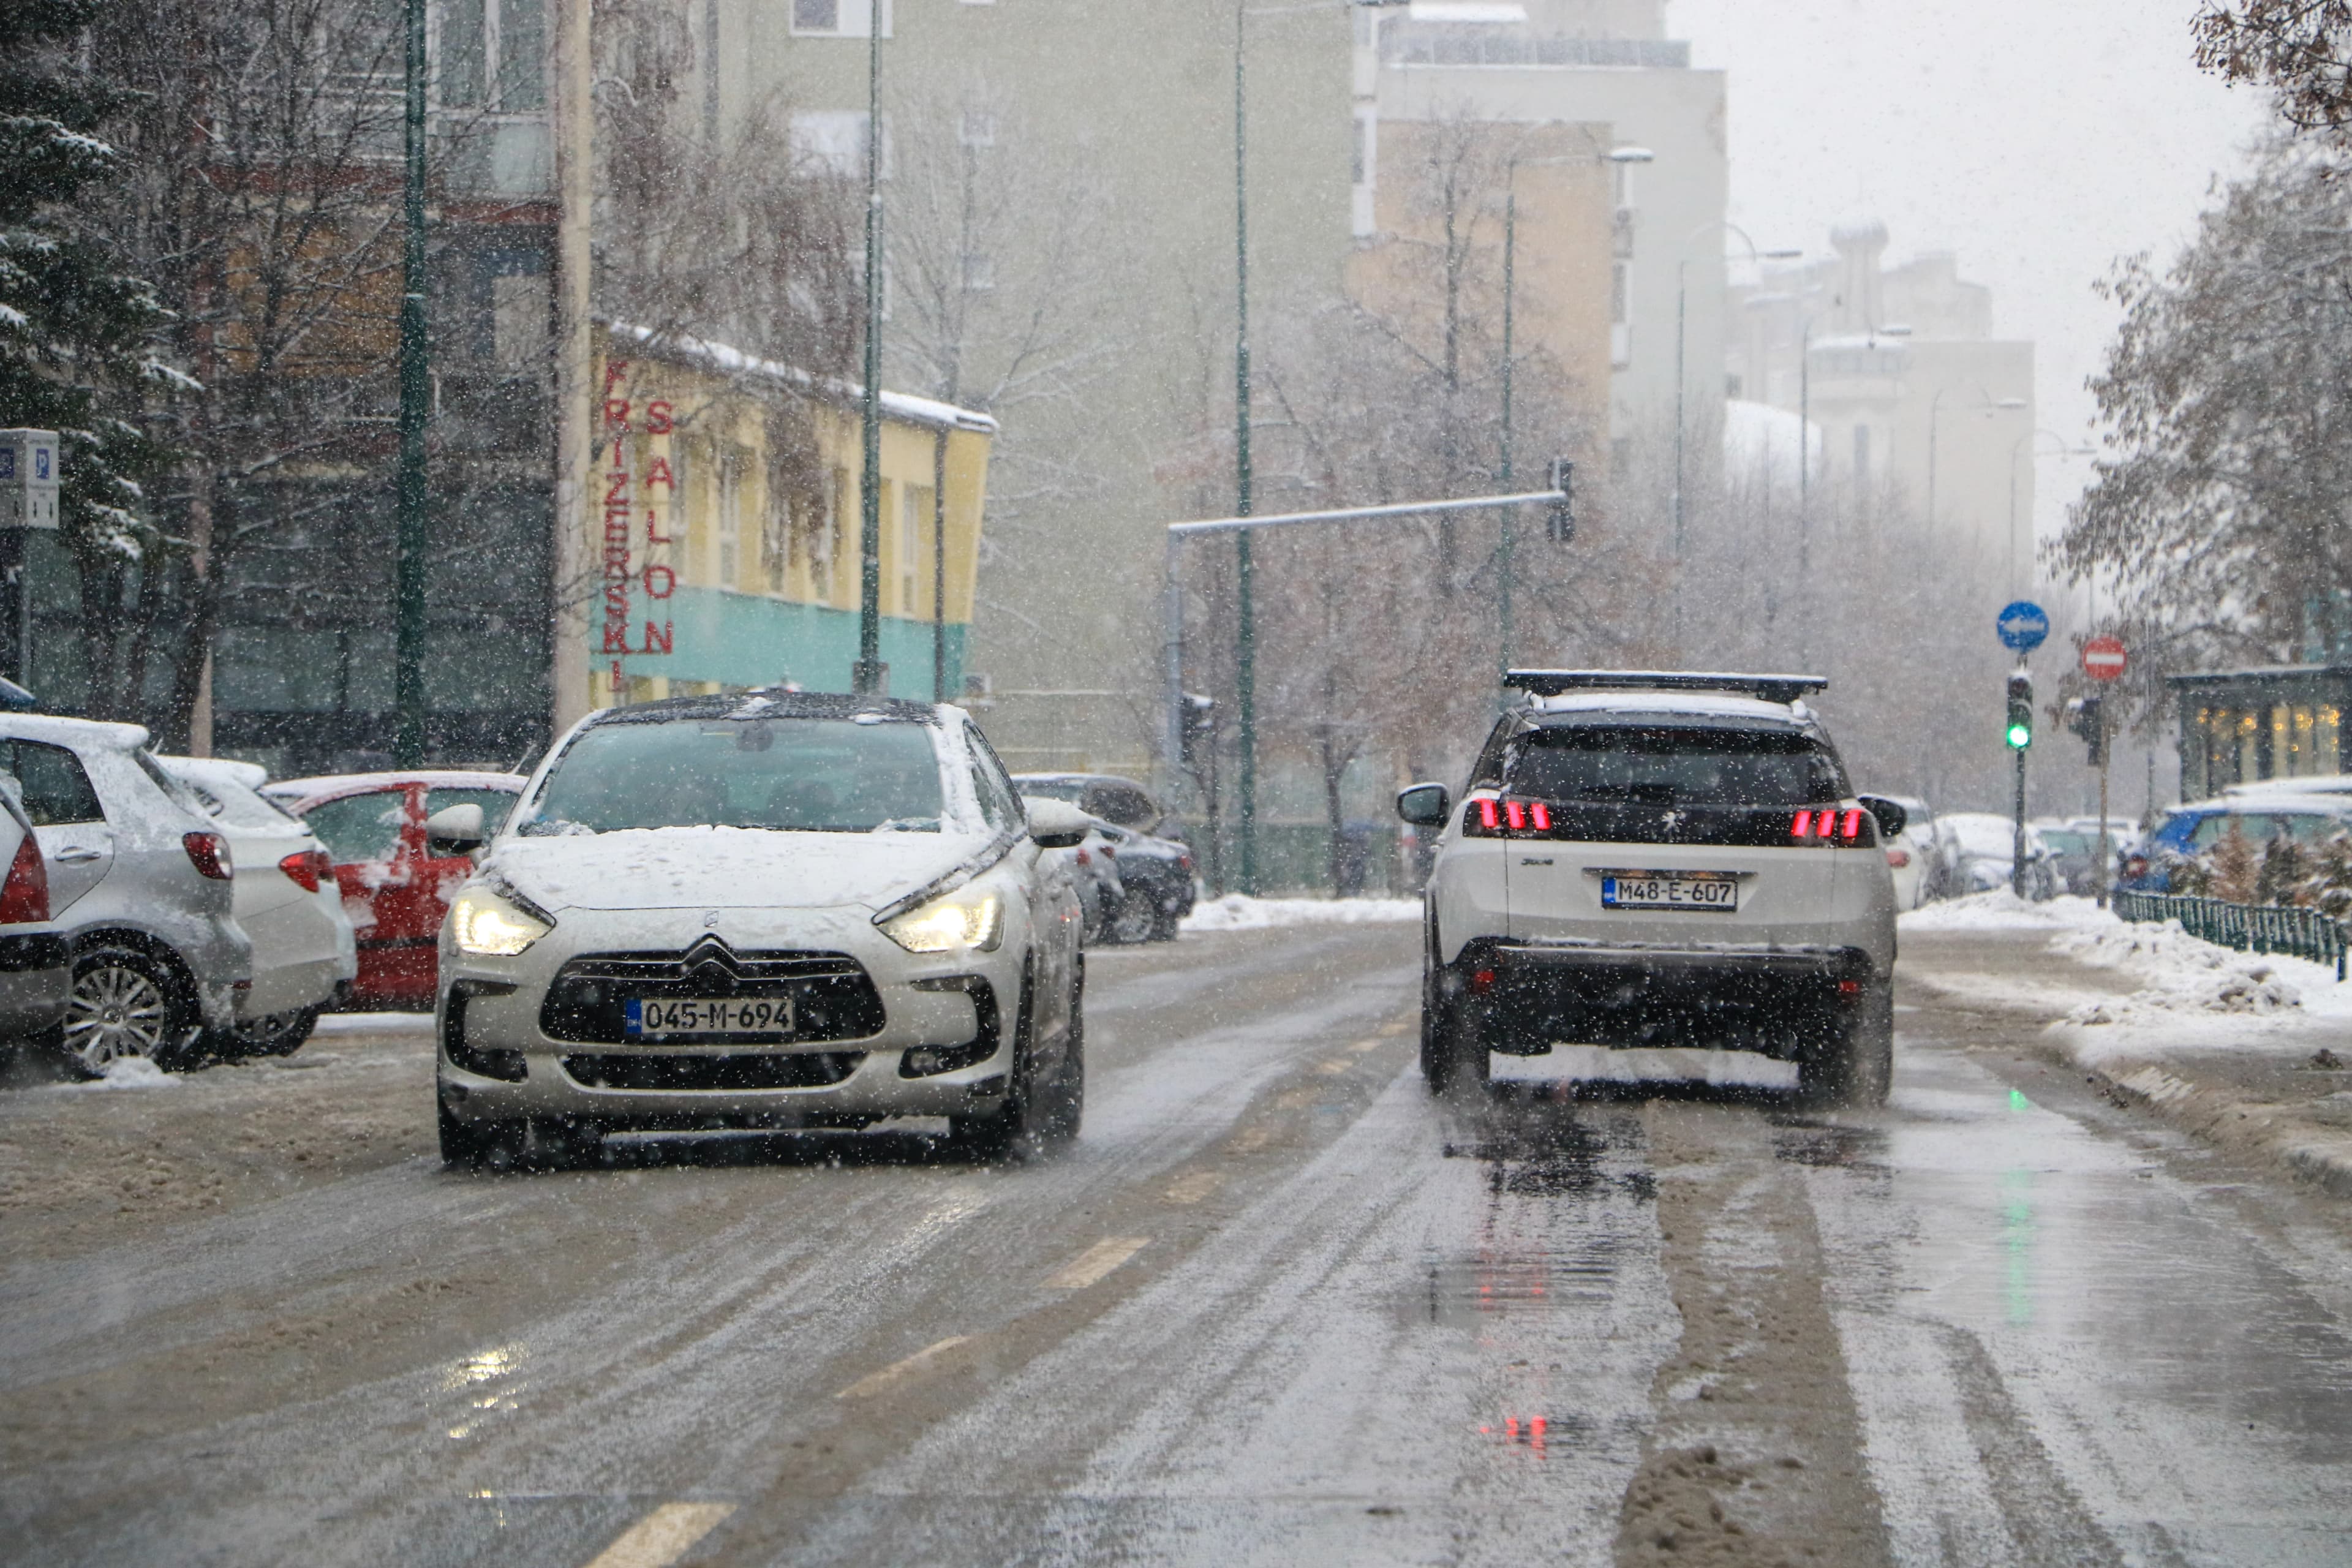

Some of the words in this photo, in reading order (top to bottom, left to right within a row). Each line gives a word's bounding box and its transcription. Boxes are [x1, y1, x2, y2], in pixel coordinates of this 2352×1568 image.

[38, 454, 47, 475] P
[604, 360, 631, 692] FRIZERSKI
[644, 400, 676, 655] SALON
[1618, 881, 1733, 903] M48-E-607
[645, 1002, 790, 1029] 045-M-694
